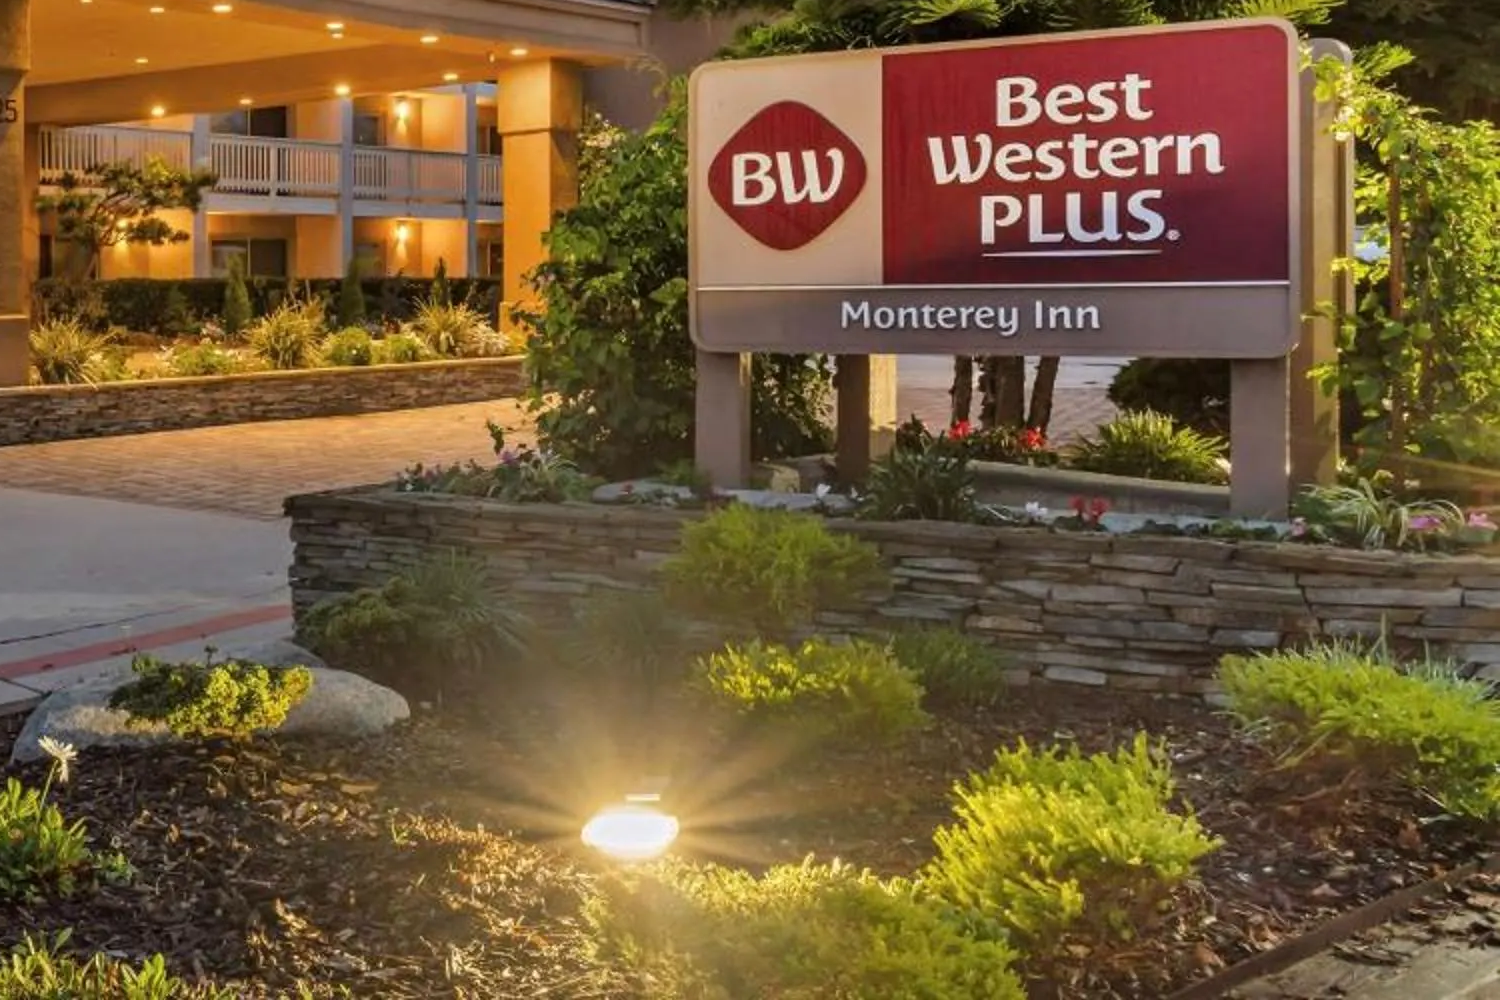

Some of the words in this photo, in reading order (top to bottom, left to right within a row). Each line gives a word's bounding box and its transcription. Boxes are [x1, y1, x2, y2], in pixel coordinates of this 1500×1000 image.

[995, 73, 1154, 127] Best
[731, 147, 845, 206] BW
[927, 132, 1226, 185] Western
[841, 300, 1020, 337] Monterey
[1034, 300, 1101, 330] Inn
